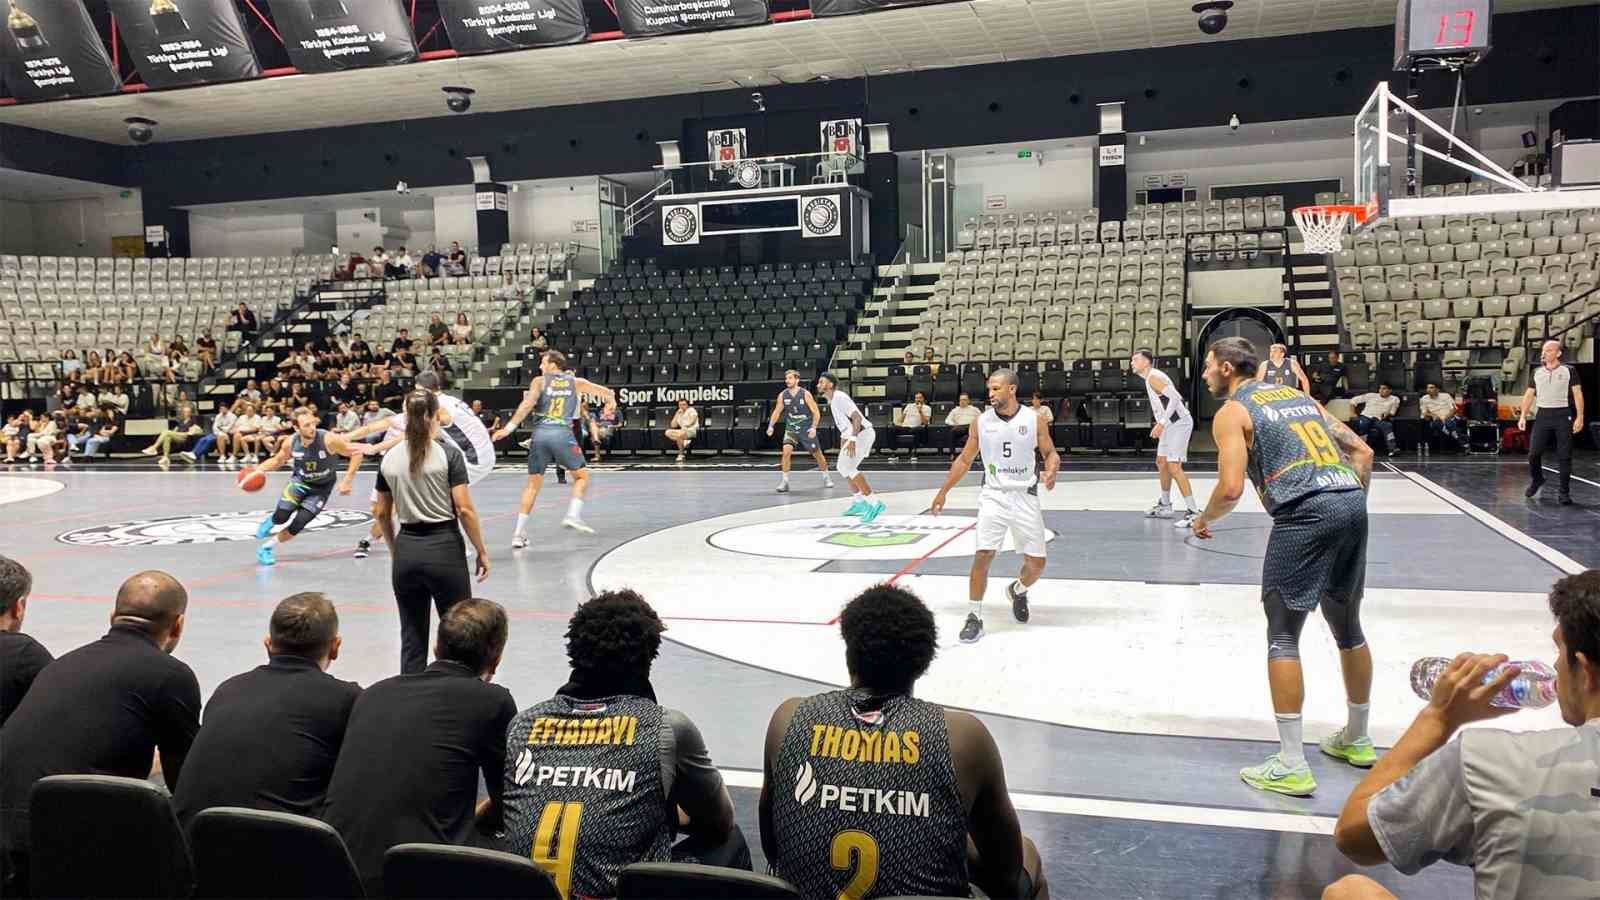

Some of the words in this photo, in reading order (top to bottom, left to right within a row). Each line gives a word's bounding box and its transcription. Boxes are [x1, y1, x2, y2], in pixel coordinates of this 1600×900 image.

[1433, 9, 1476, 46] 13
[619, 388, 653, 406] Spor
[657, 385, 734, 404] Kompleksi
[1002, 441, 1012, 458] 5
[1289, 420, 1340, 467] 19
[810, 723, 921, 764] THOMAS
[530, 801, 585, 900] 4
[830, 829, 880, 900] 2
